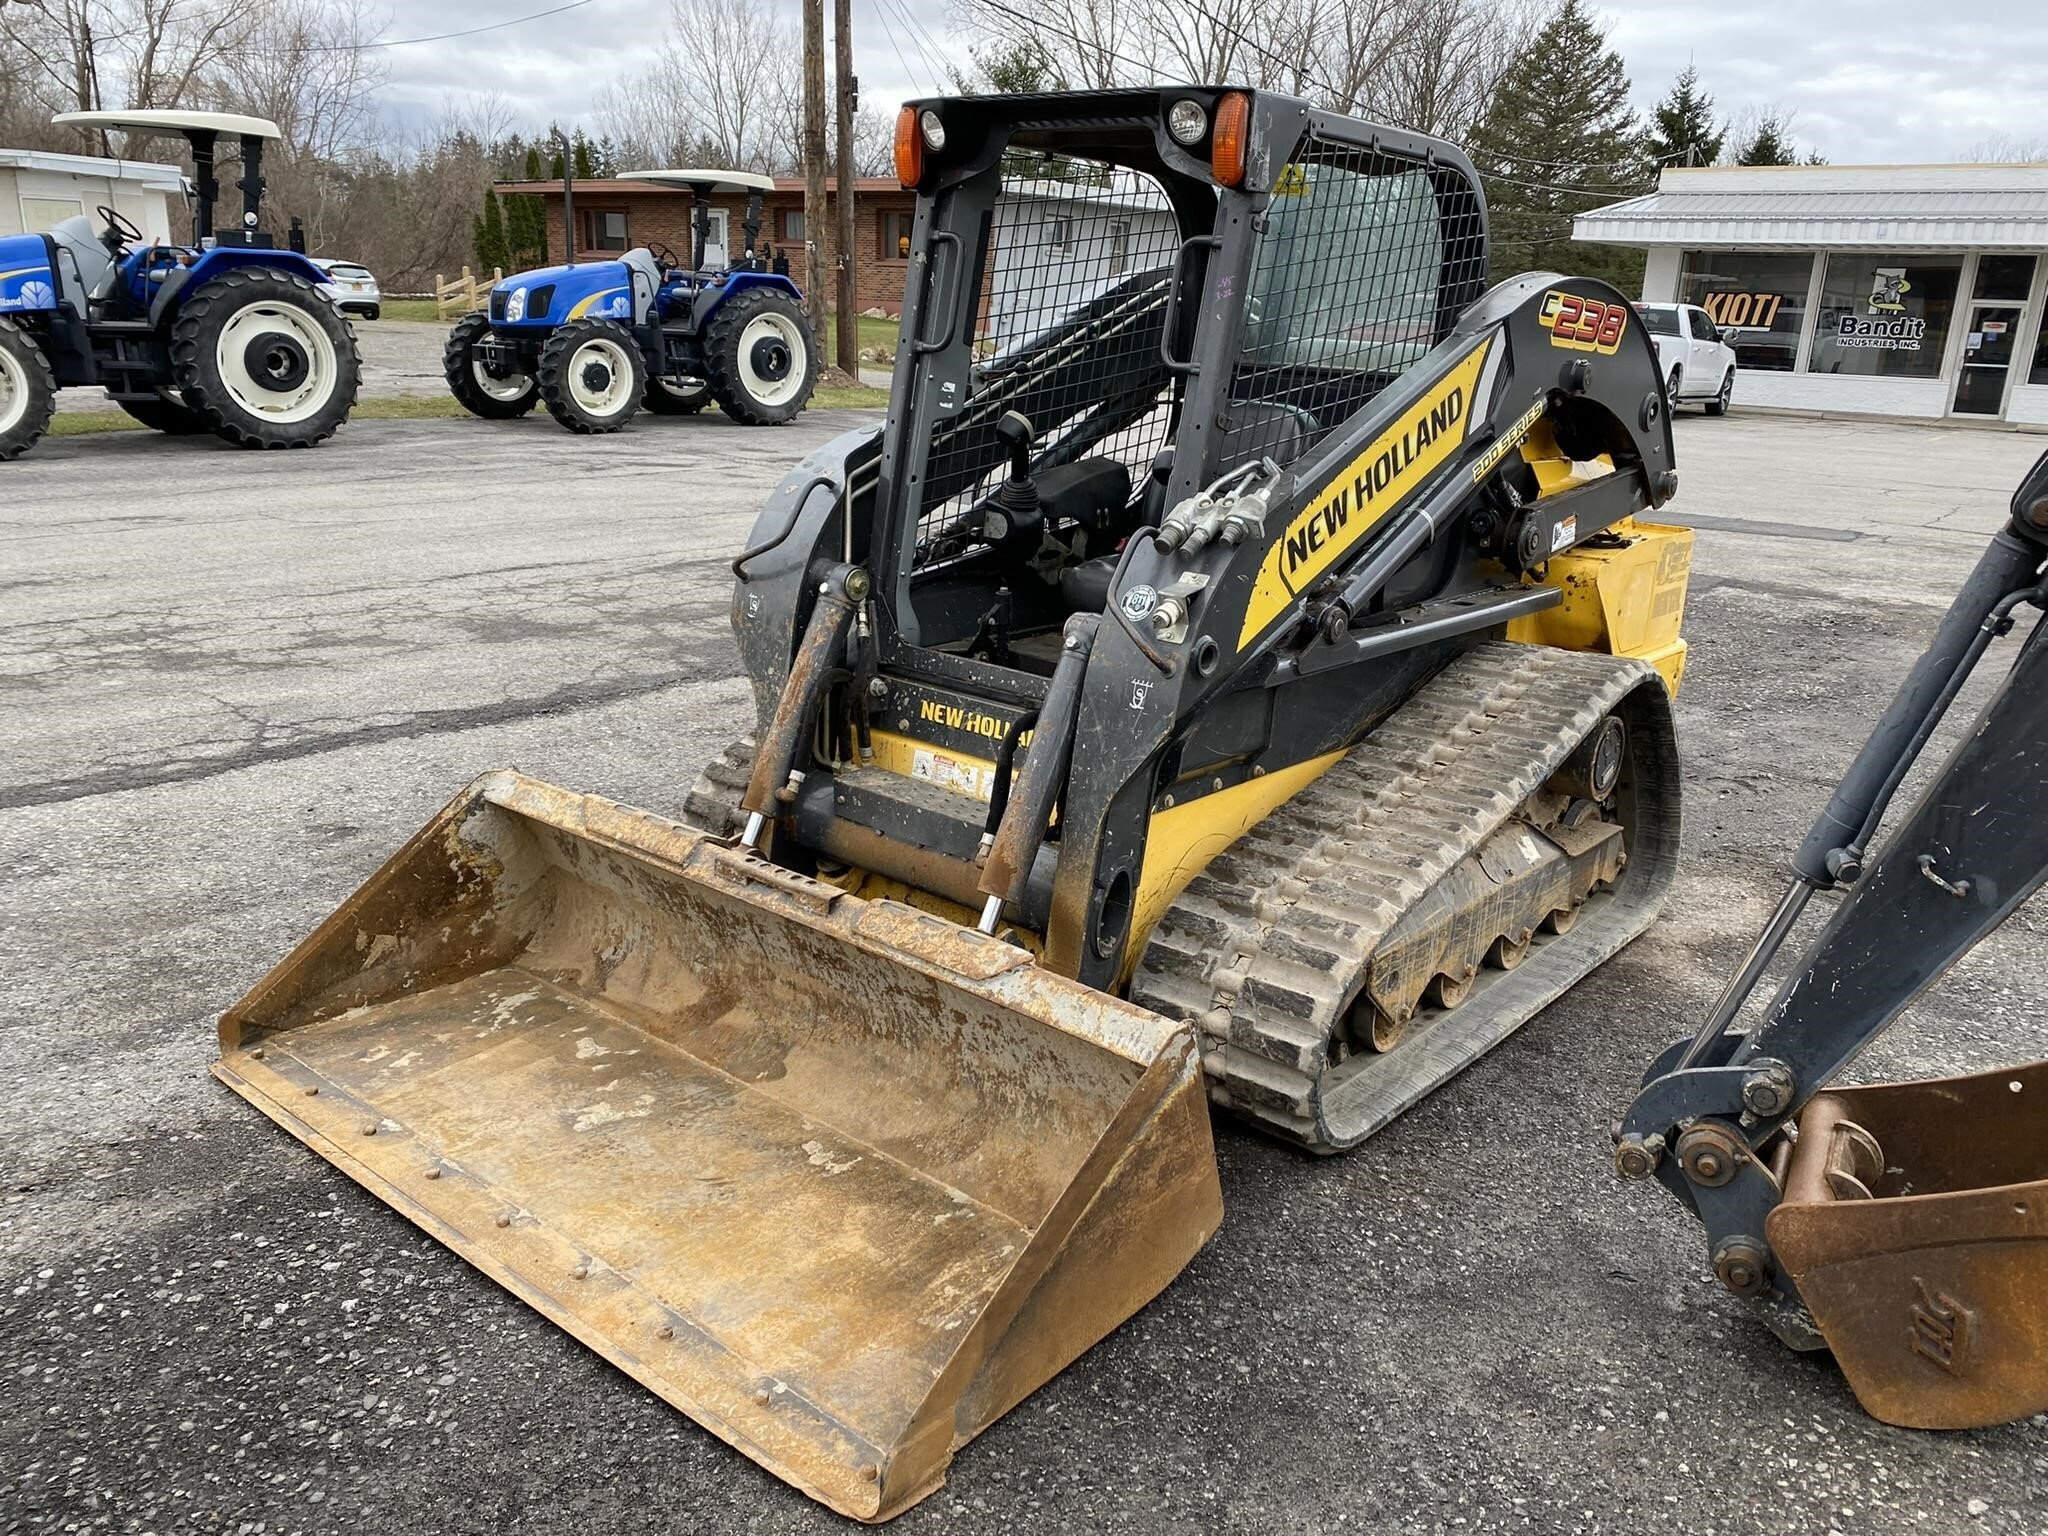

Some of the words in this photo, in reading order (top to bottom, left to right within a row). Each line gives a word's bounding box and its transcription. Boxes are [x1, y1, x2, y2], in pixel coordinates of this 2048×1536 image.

[1703, 292, 1782, 327] KIOTI
[1838, 315, 1926, 339] Bandit
[1836, 337, 1899, 350] INDUSTRIES,
[1899, 339, 1920, 350] INC.
[1472, 446, 1500, 482] 200
[1500, 400, 1543, 453] SERIES
[1286, 486, 1348, 574] NEW
[1354, 386, 1463, 512] HOLLAND
[1131, 592, 1148, 606] 811
[920, 699, 964, 729] NEW
